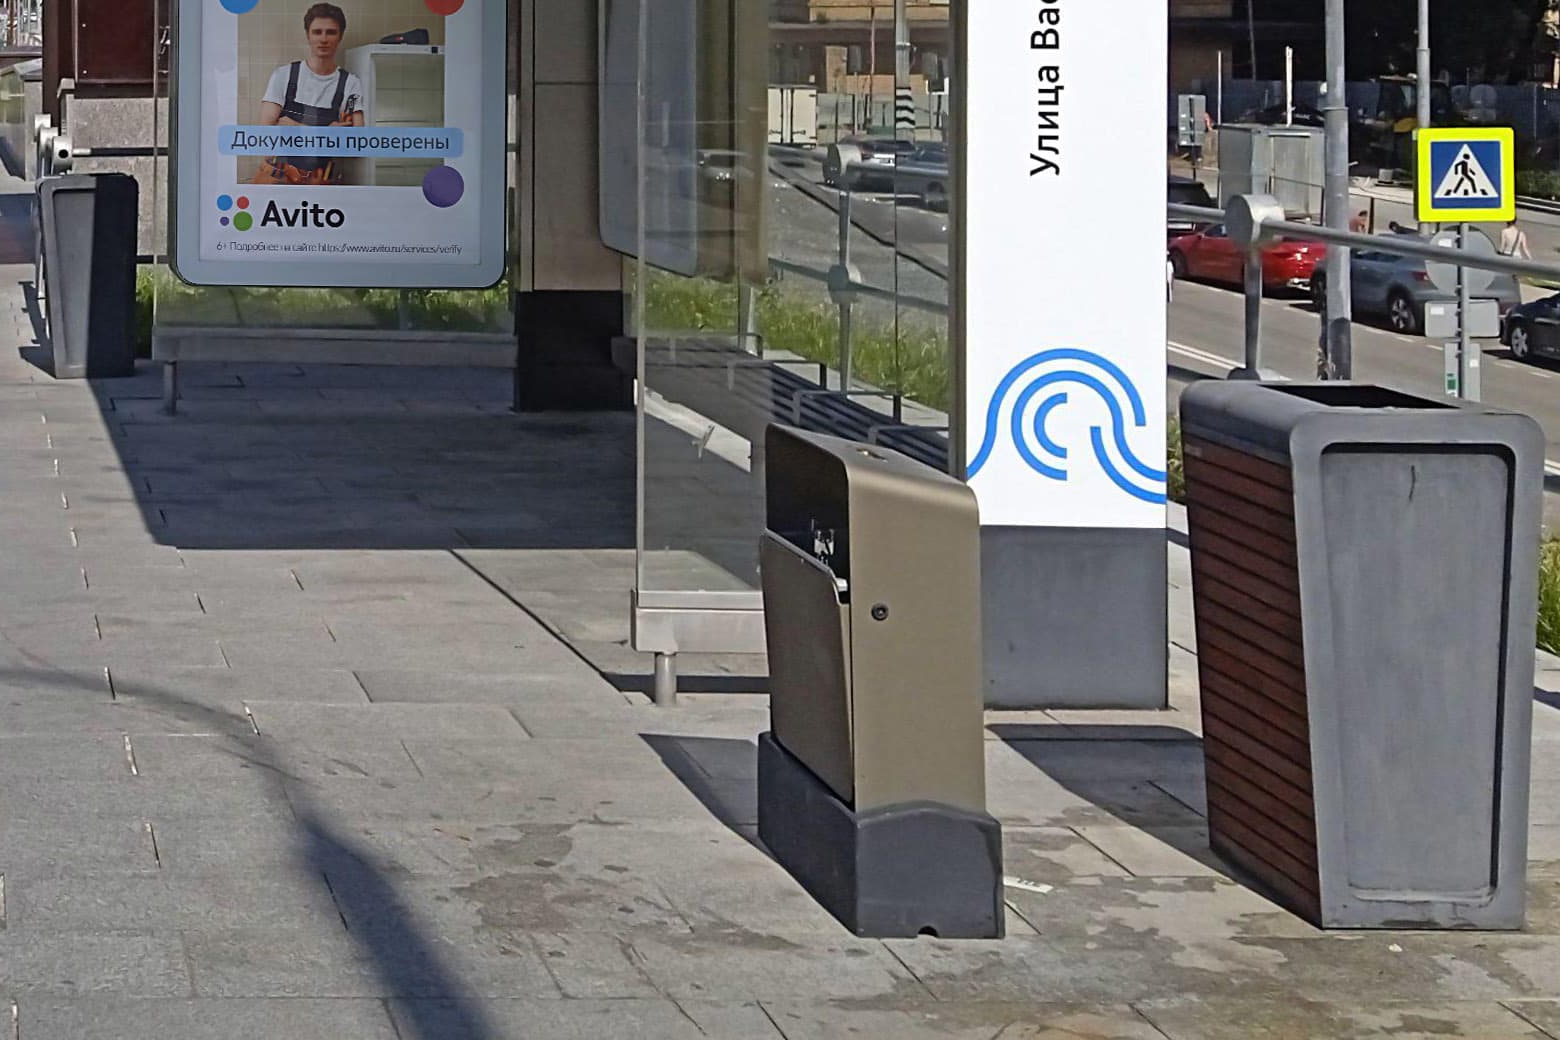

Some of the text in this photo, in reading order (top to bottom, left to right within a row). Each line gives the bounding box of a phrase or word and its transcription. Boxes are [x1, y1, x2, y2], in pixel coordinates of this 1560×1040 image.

[1030, 65, 1065, 177] Улица
[231, 130, 449, 153] Документы проверены
[260, 199, 345, 228] Avito
